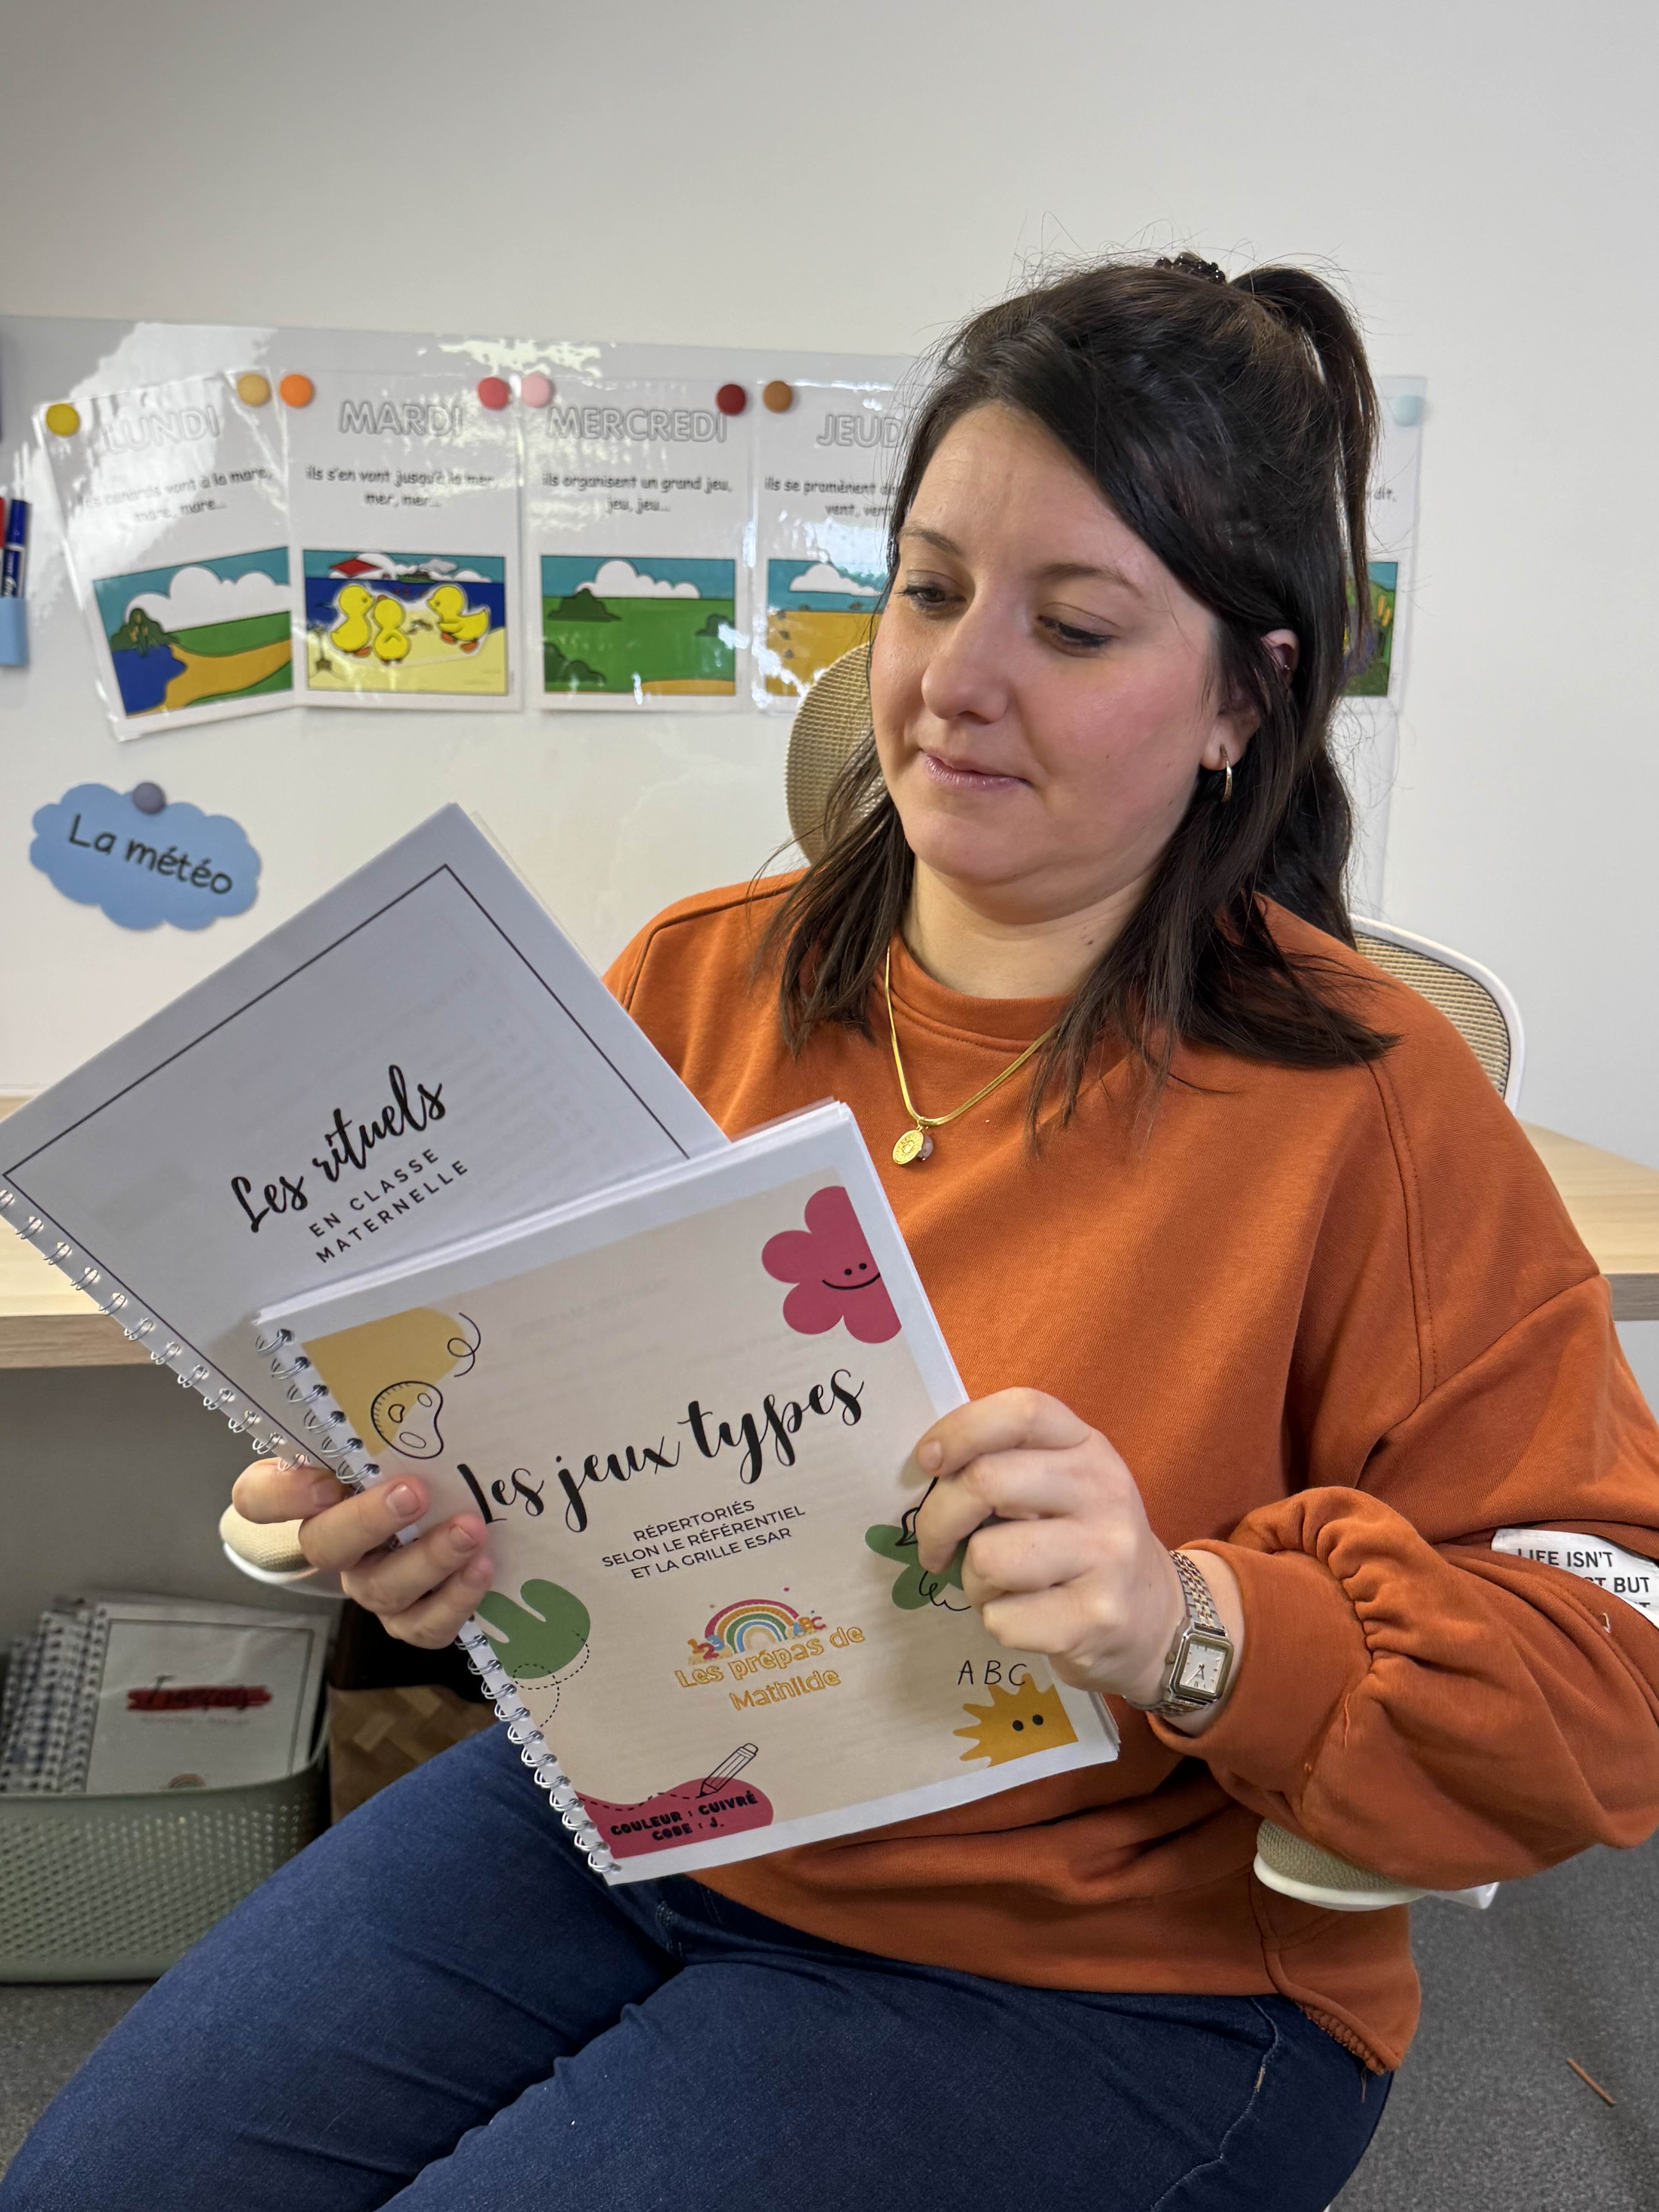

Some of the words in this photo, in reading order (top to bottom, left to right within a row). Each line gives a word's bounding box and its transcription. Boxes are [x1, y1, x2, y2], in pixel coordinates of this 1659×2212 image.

[103, 404, 220, 455] LUNDI
[338, 399, 464, 436] MARDI
[545, 406, 728, 443] MERCREDI
[816, 413, 904, 448] JEUD
[213, 471, 228, 487] la
[306, 466, 323, 481] ils
[359, 470, 390, 481] vont
[542, 472, 559, 487] ils
[563, 476, 637, 491] organisent
[640, 477, 658, 489] un
[661, 476, 702, 493] grand
[704, 478, 733, 494] jeu,
[764, 476, 780, 491] ils
[783, 480, 800, 491] se
[803, 478, 876, 496] promènent
[605, 498, 633, 514] jeu,
[68, 813, 117, 855] La
[124, 838, 233, 895] météo
[230, 1176, 308, 1233] Les
[311, 1064, 446, 1183] rituels
[308, 1212, 342, 1238] EN
[349, 1148, 439, 1211] CLASSE
[315, 1160, 468, 1263] MATERNELLE
[456, 1463, 545, 1525] Les
[555, 1435, 680, 1534] jeux
[677, 1368, 864, 1485] types
[602, 1544, 659, 1568] SELON
[663, 1537, 685, 1553] LE
[687, 1505, 806, 1546] RÉFÉRENTIEL
[633, 1499, 755, 1542] RÉPERTORIÉS
[631, 1565, 652, 1579] ET
[655, 1559, 680, 1573] LA
[681, 1541, 742, 1566] GRILLE
[744, 1527, 792, 1549] ESAR
[1567, 1551, 1613, 1568] ISN'T
[1614, 1577, 1649, 1593] BUT
[674, 1666, 724, 1687] Les
[728, 1637, 824, 1681] prépas
[829, 1626, 866, 1649] de
[729, 1669, 842, 1711] Mathilde
[610, 1811, 683, 1836] COULEUR
[698, 1790, 758, 1815] CUIVRÉ
[652, 1823, 693, 1841] CODE
[709, 1817, 725, 1828] J.
